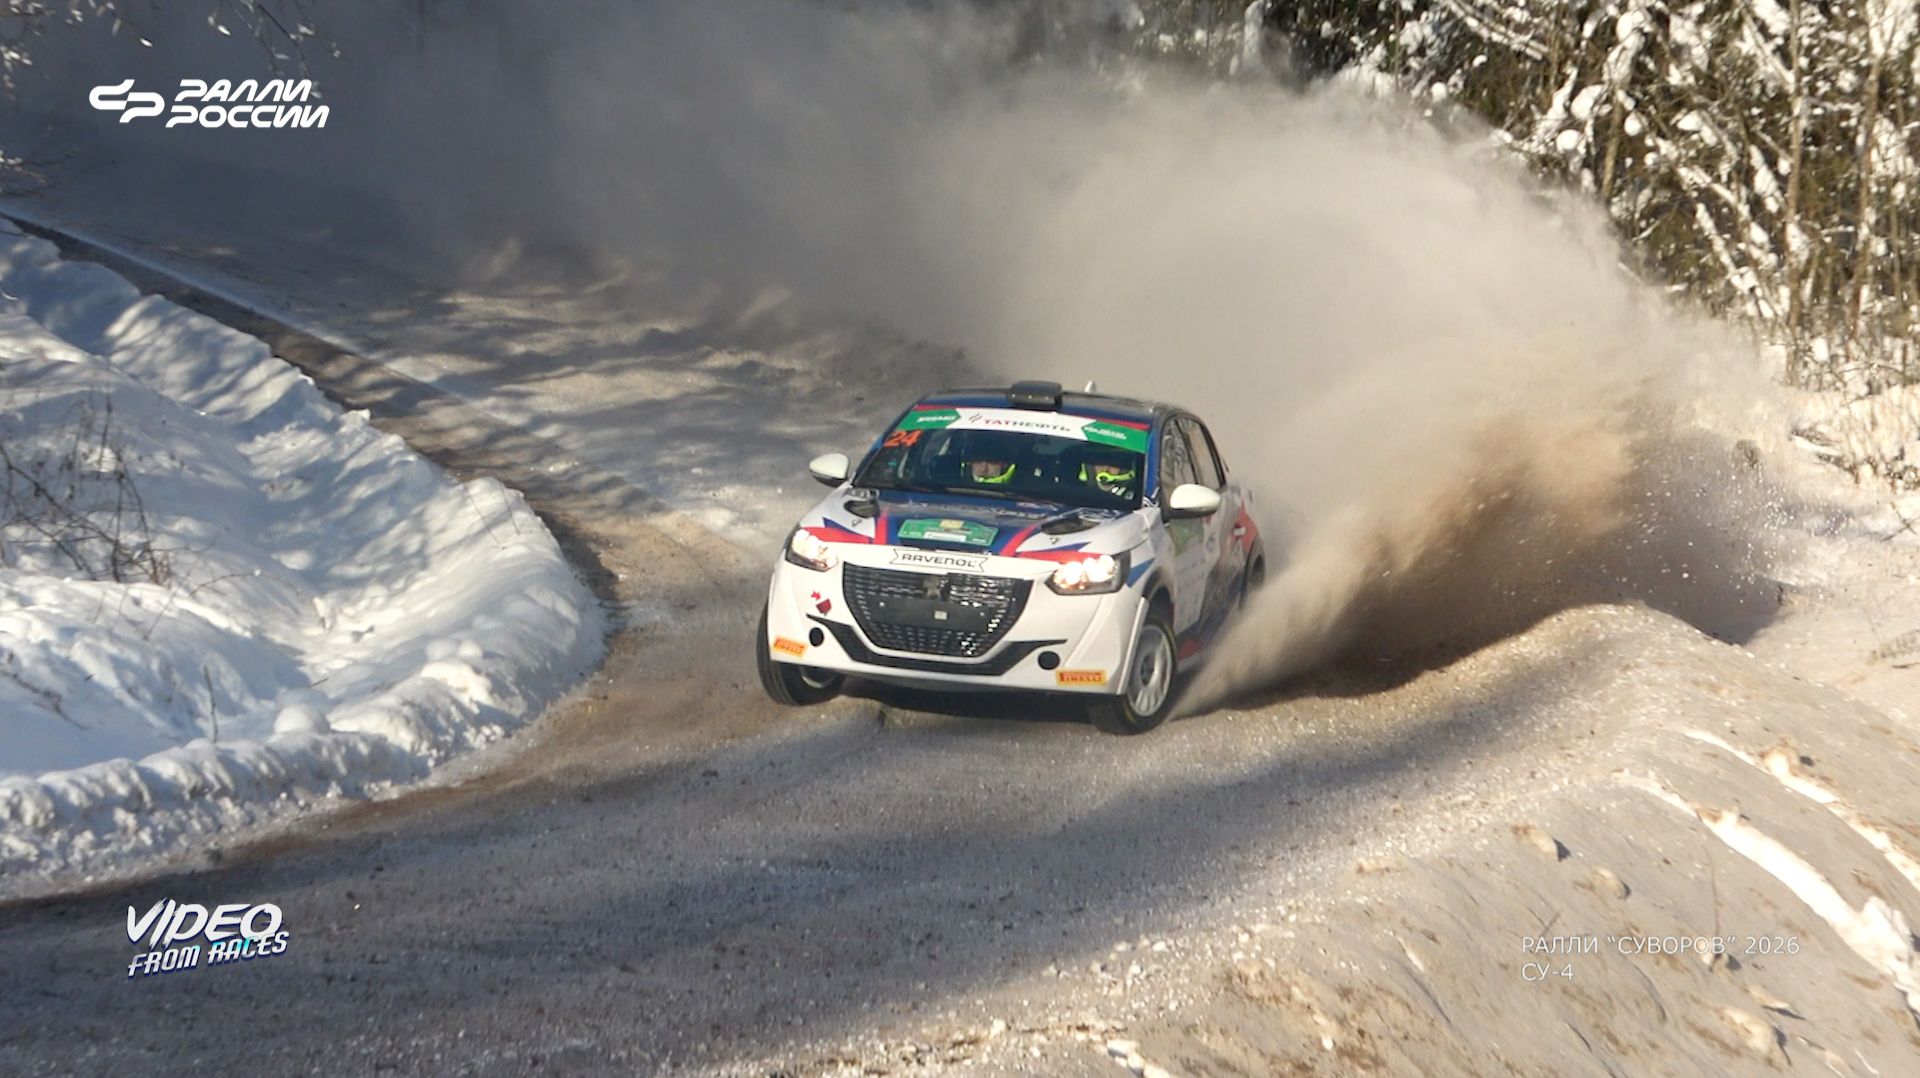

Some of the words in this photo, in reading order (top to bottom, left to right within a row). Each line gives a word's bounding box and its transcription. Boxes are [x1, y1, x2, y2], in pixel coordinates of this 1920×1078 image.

[983, 417, 1071, 432] ТАТНЕФТЬ
[883, 430, 924, 448] 24
[901, 553, 976, 568] RAVENOL
